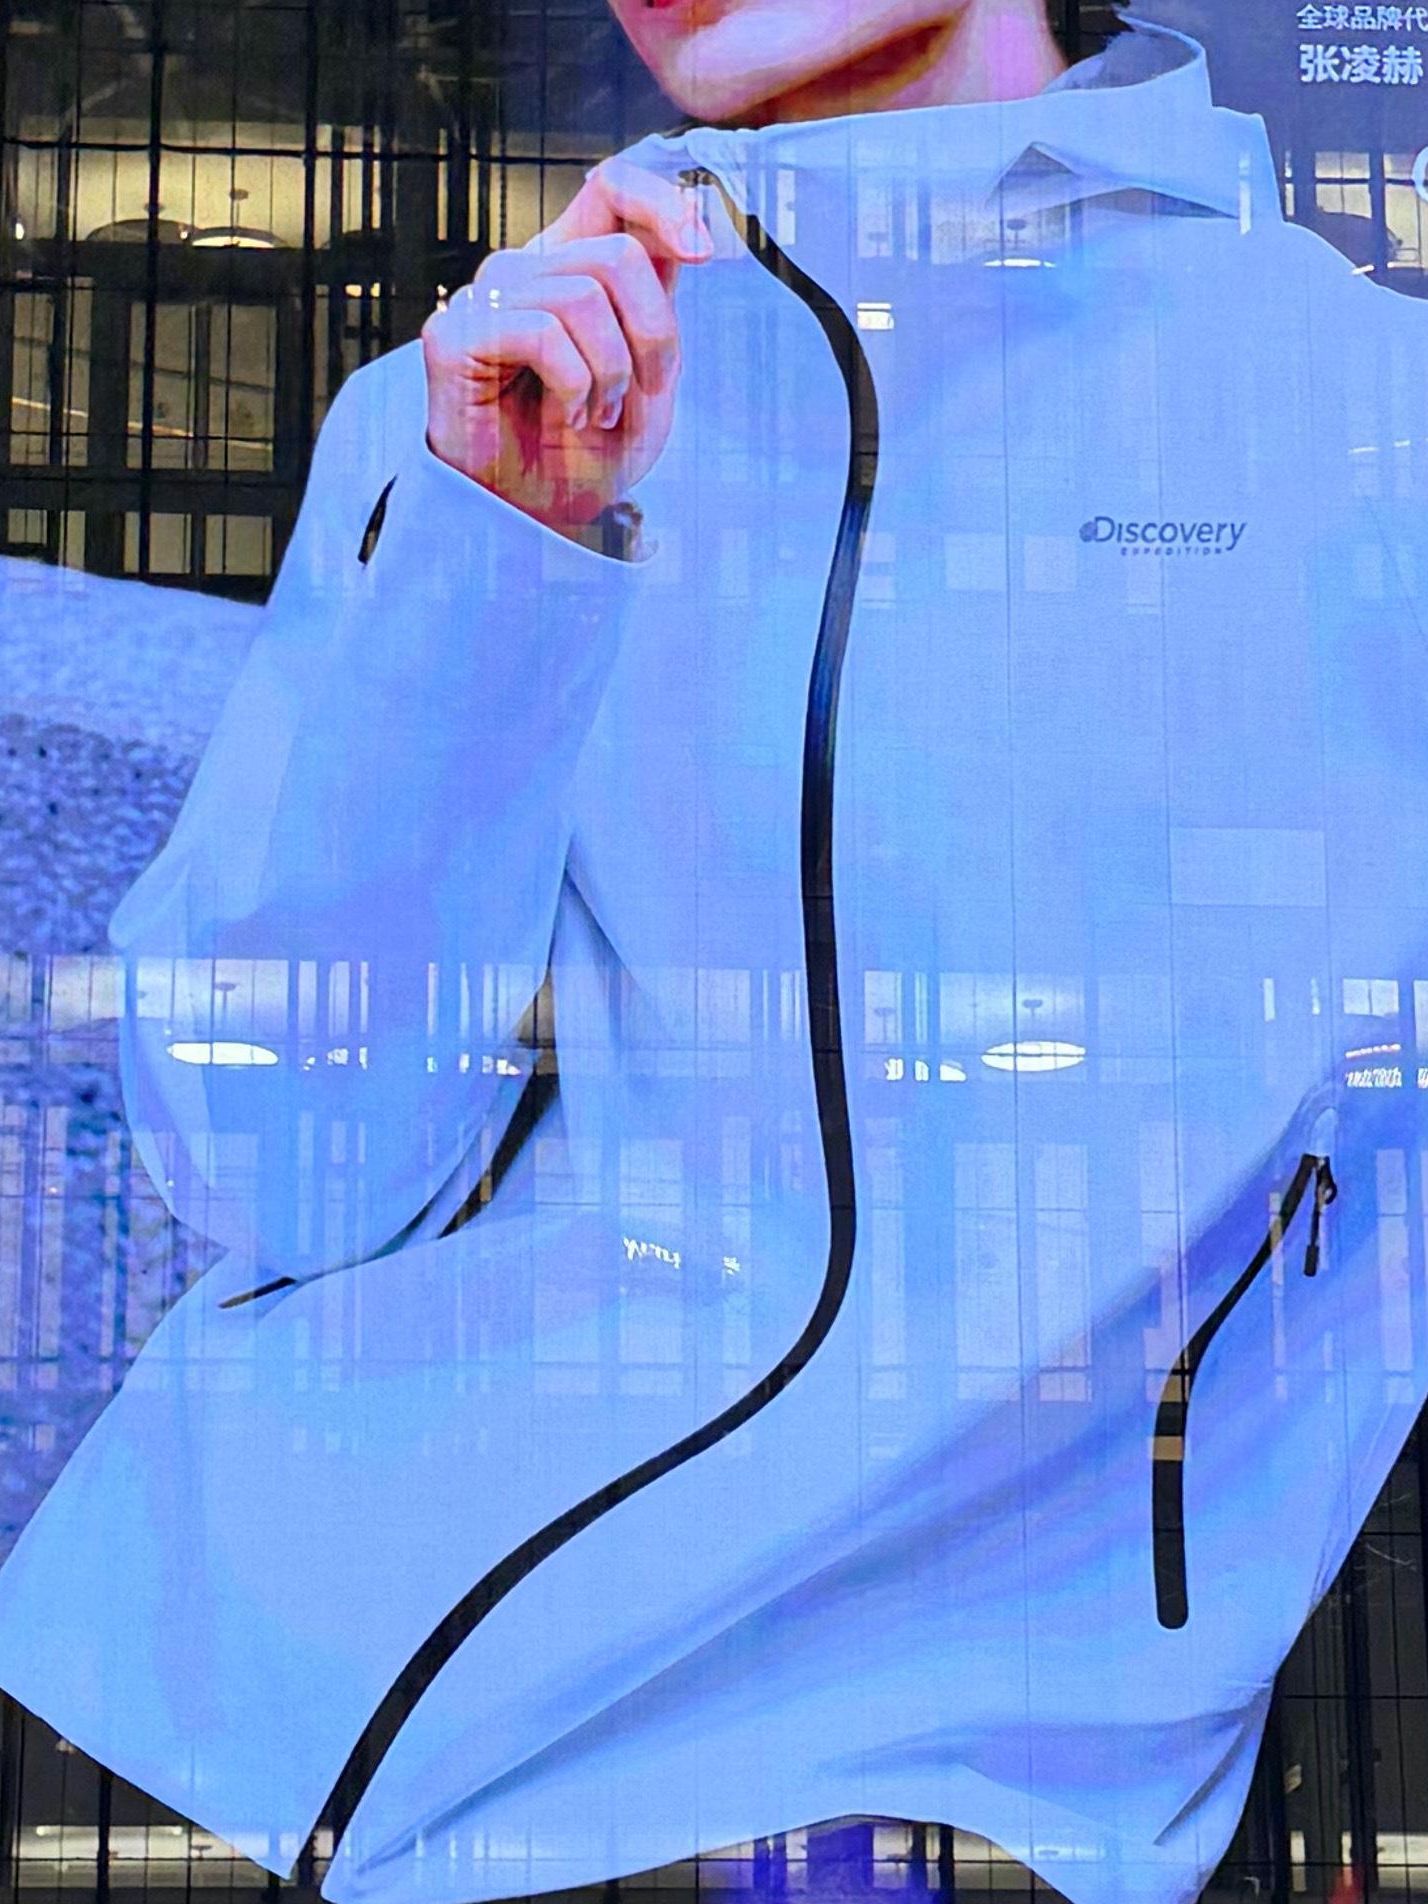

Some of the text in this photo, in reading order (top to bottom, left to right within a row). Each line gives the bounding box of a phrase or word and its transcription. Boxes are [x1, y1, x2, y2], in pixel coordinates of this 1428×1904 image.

[1299, 44, 1424, 85] 张凌赫
[1094, 516, 1247, 551] Discovery
